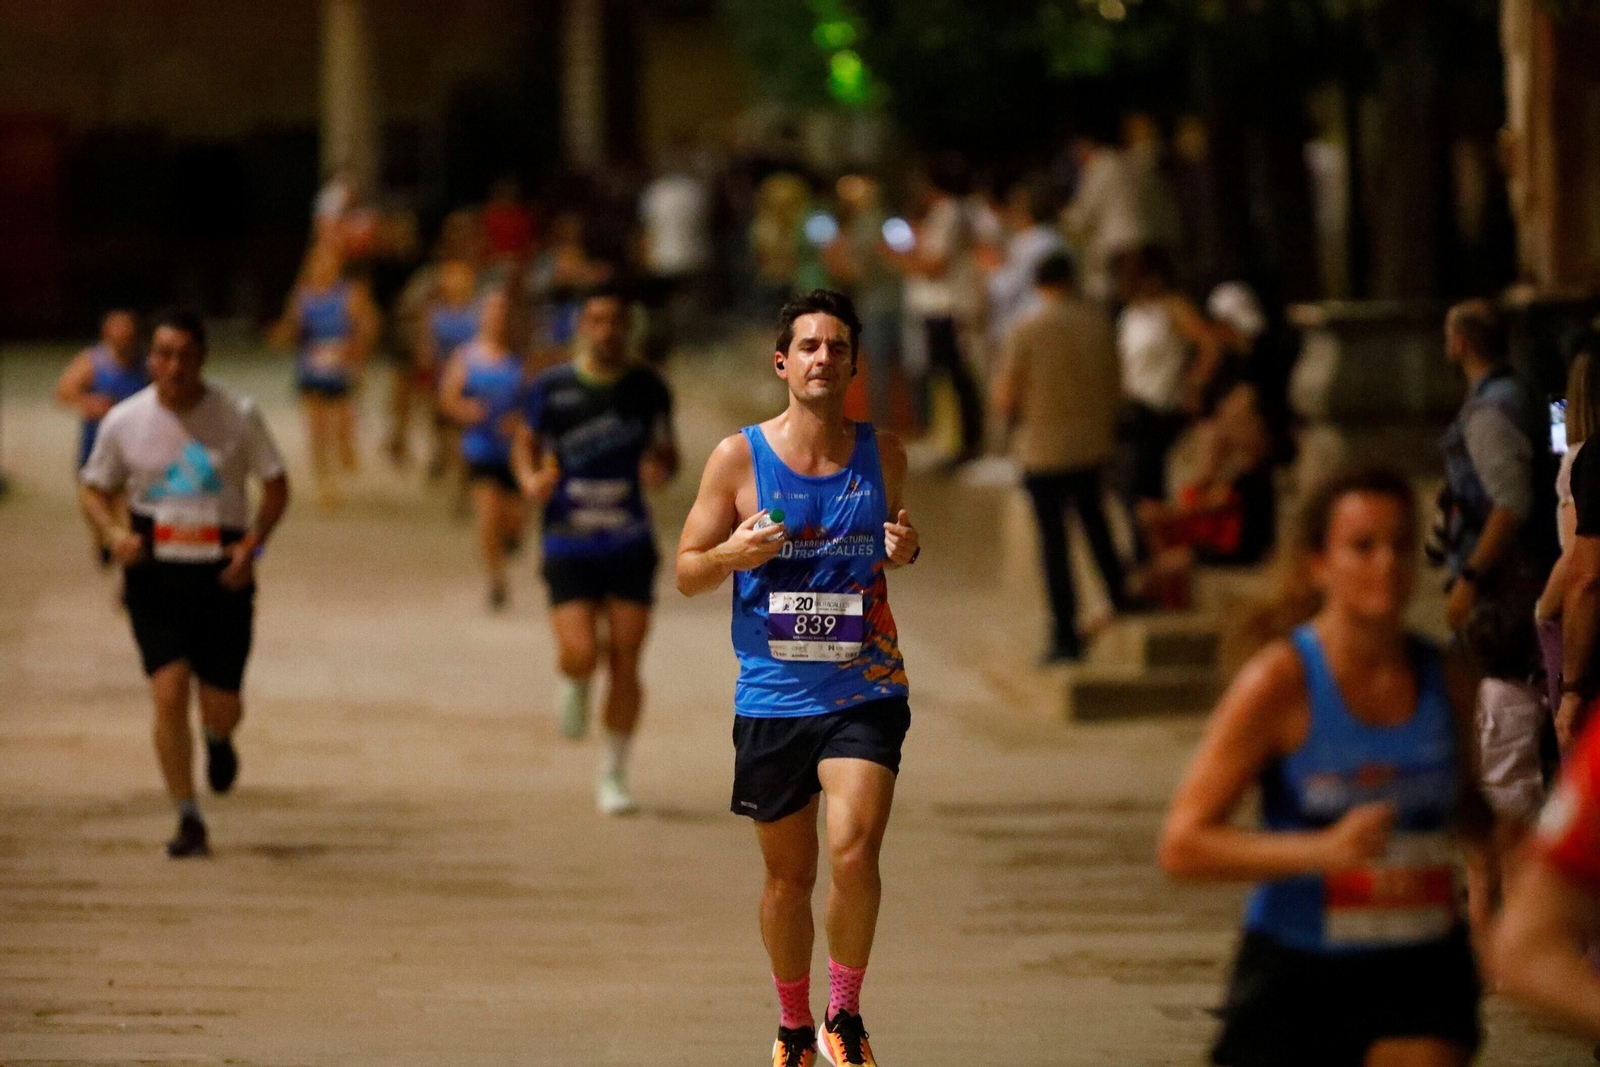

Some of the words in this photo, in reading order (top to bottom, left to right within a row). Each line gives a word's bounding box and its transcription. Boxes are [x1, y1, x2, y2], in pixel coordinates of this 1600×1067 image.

[832, 535, 874, 545] NOCTURNA
[795, 597, 814, 611] 20
[794, 615, 836, 635] 839
